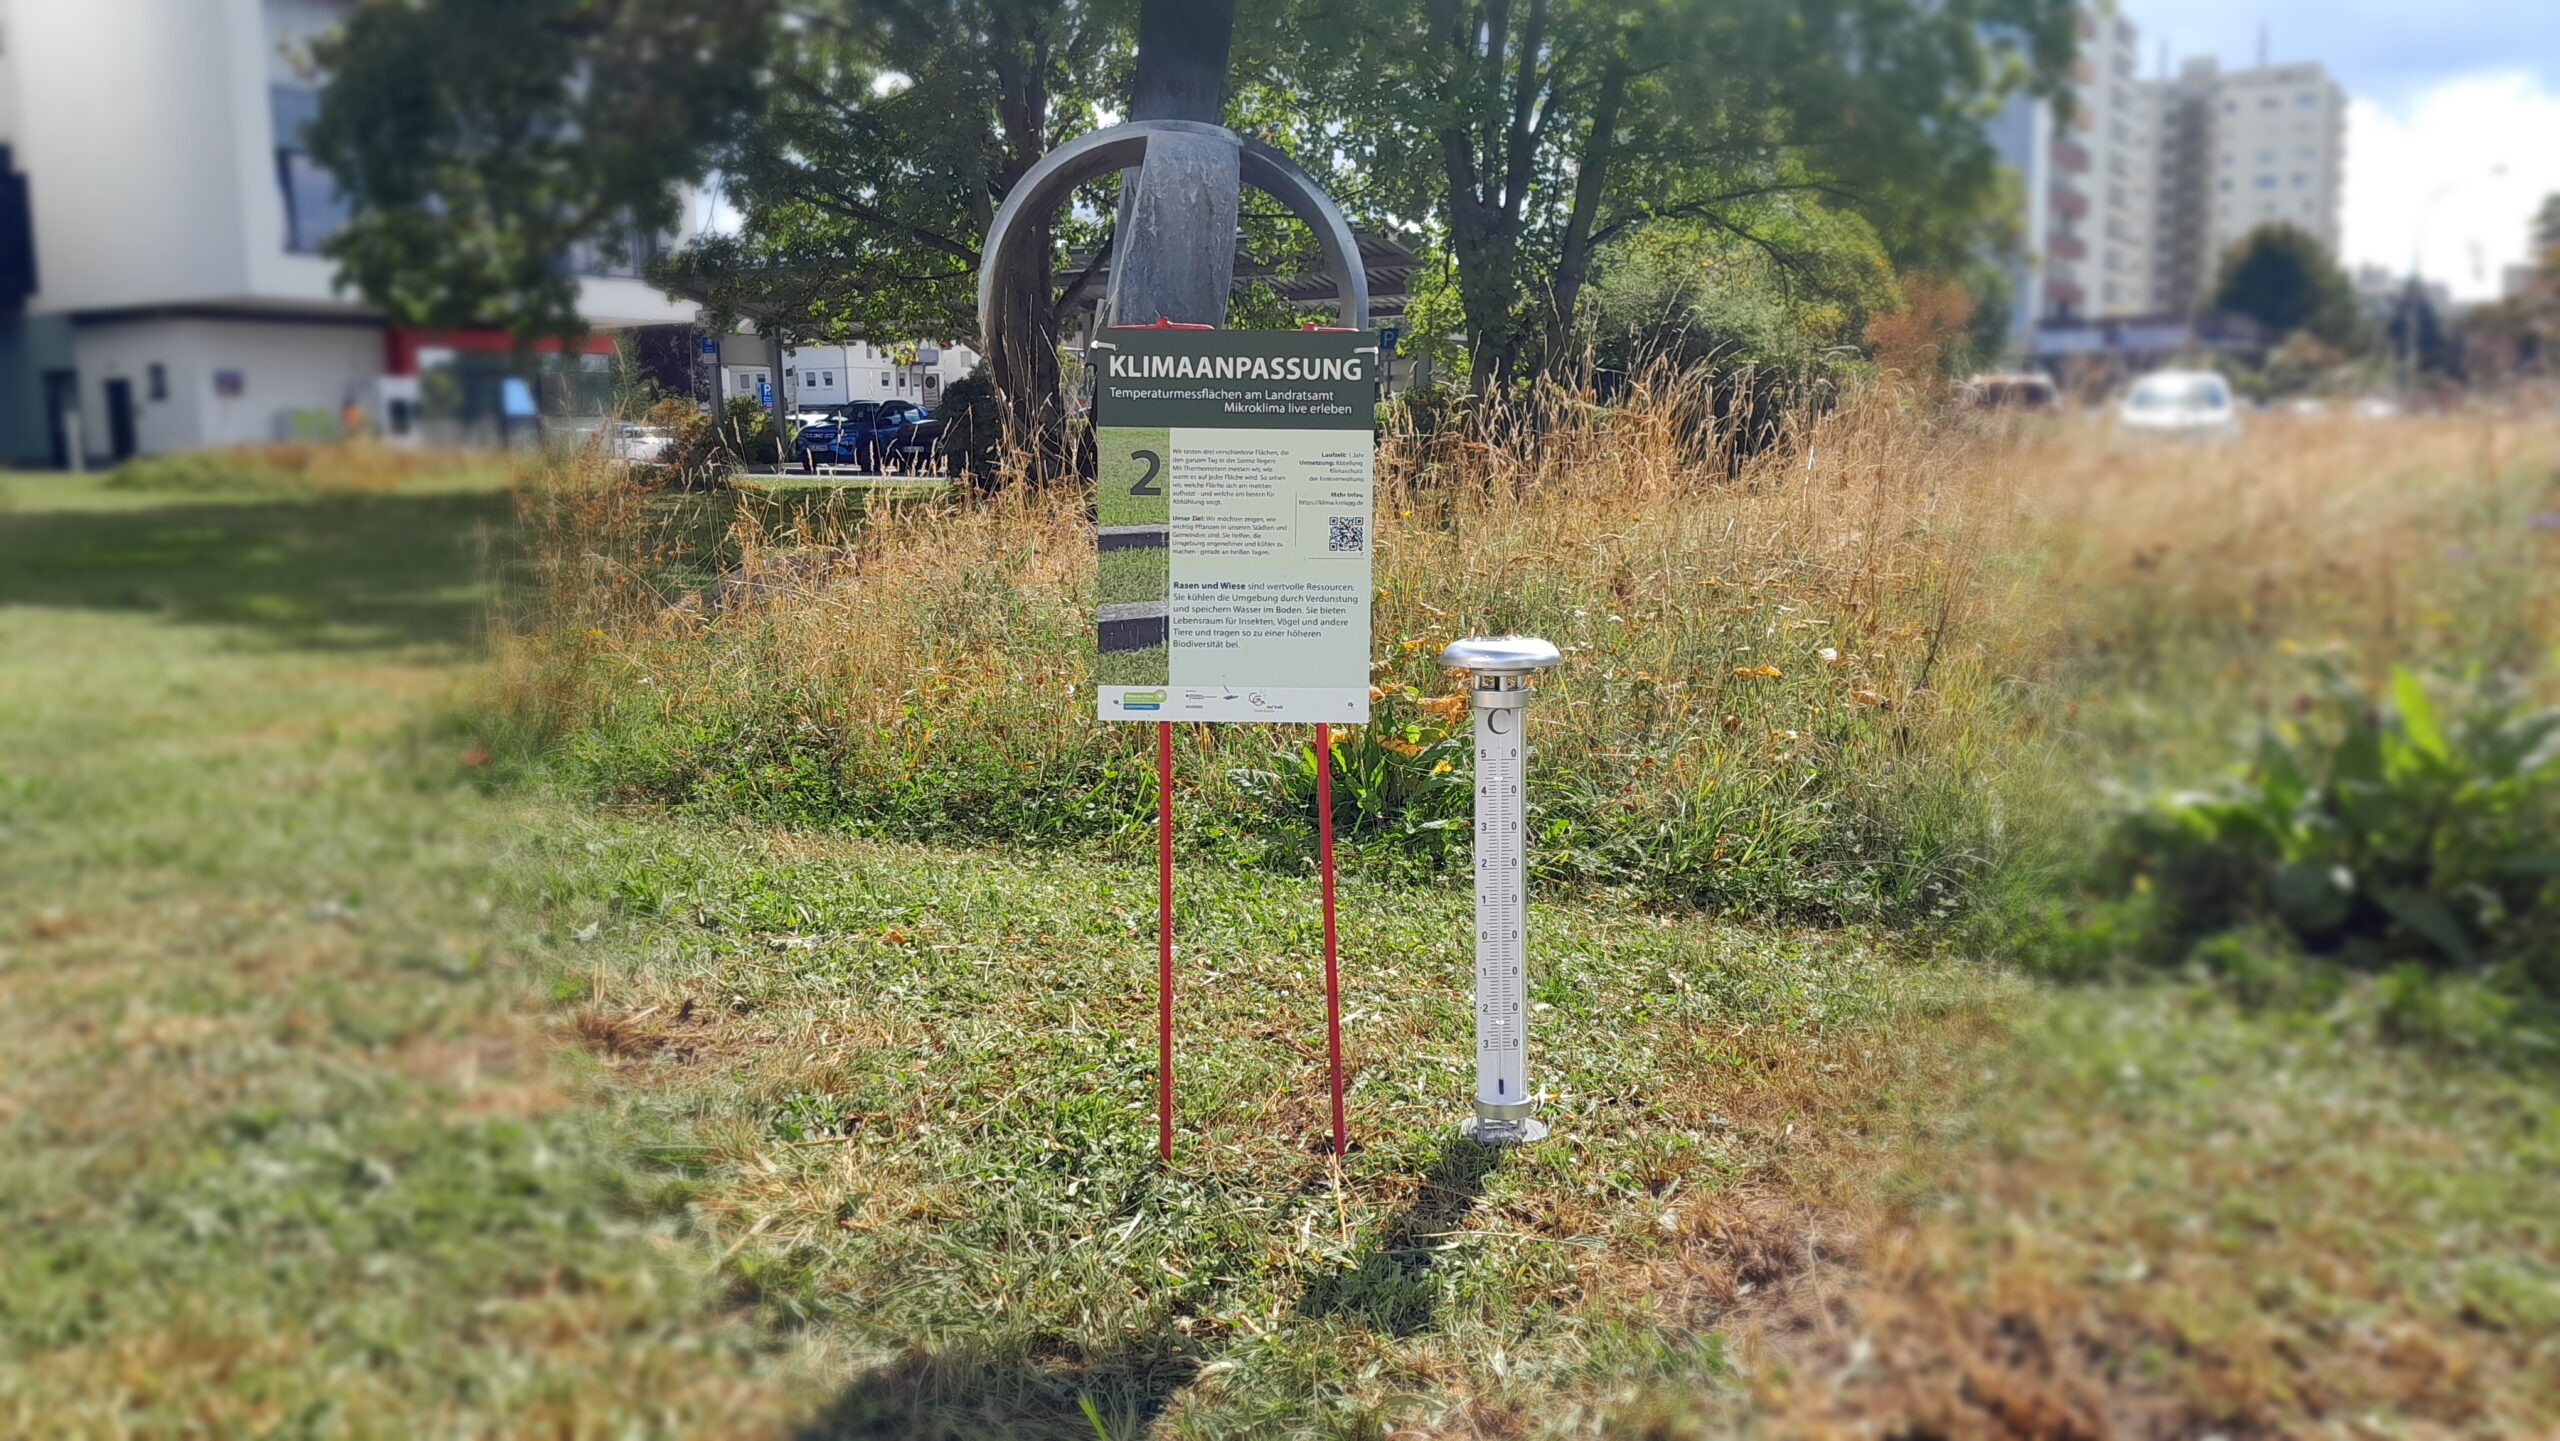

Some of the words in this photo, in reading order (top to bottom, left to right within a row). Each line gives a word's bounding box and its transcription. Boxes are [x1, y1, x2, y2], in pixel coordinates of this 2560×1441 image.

[1384, 331, 1394, 347] P
[1109, 355, 1362, 380] KLIMAANPASSUNG
[1109, 387, 1242, 400] Temperaturmessflächen
[1265, 389, 1334, 401] Landratsamt
[1224, 402, 1285, 413] Mikroklima
[1288, 403, 1307, 413] live
[1310, 403, 1352, 414] erleben
[1130, 449, 1162, 496] 2
[1173, 581, 1199, 589] Rasen
[1173, 593, 1186, 601] Sie
[1187, 593, 1215, 601] kühlen
[1232, 594, 1279, 603] Umgebung
[1305, 595, 1359, 605] Verdunstung
[1191, 605, 1231, 614] speichern
[1277, 618, 1300, 627] Vögel
[1173, 628, 1193, 636] Tiere
[1213, 630, 1240, 638] tragen
[1173, 640, 1223, 648] Biodiversität
[1225, 640, 1240, 648] bei.
[1487, 708, 1512, 734] C
[1480, 749, 1487, 758] 5
[1511, 749, 1517, 757] 0
[1481, 786, 1487, 795] 4
[1511, 785, 1517, 794] 0
[1481, 823, 1487, 831] 3
[1511, 822, 1517, 830] 0
[1481, 859, 1487, 867] 2
[1511, 858, 1517, 866] 0
[1482, 896, 1486, 904] 1
[1511, 894, 1517, 903] 0
[1482, 931, 1488, 940] 0
[1512, 930, 1518, 939] 0
[1512, 967, 1518, 975] 0
[1512, 1003, 1518, 1011] 0
[1513, 1039, 1518, 1047] 0
